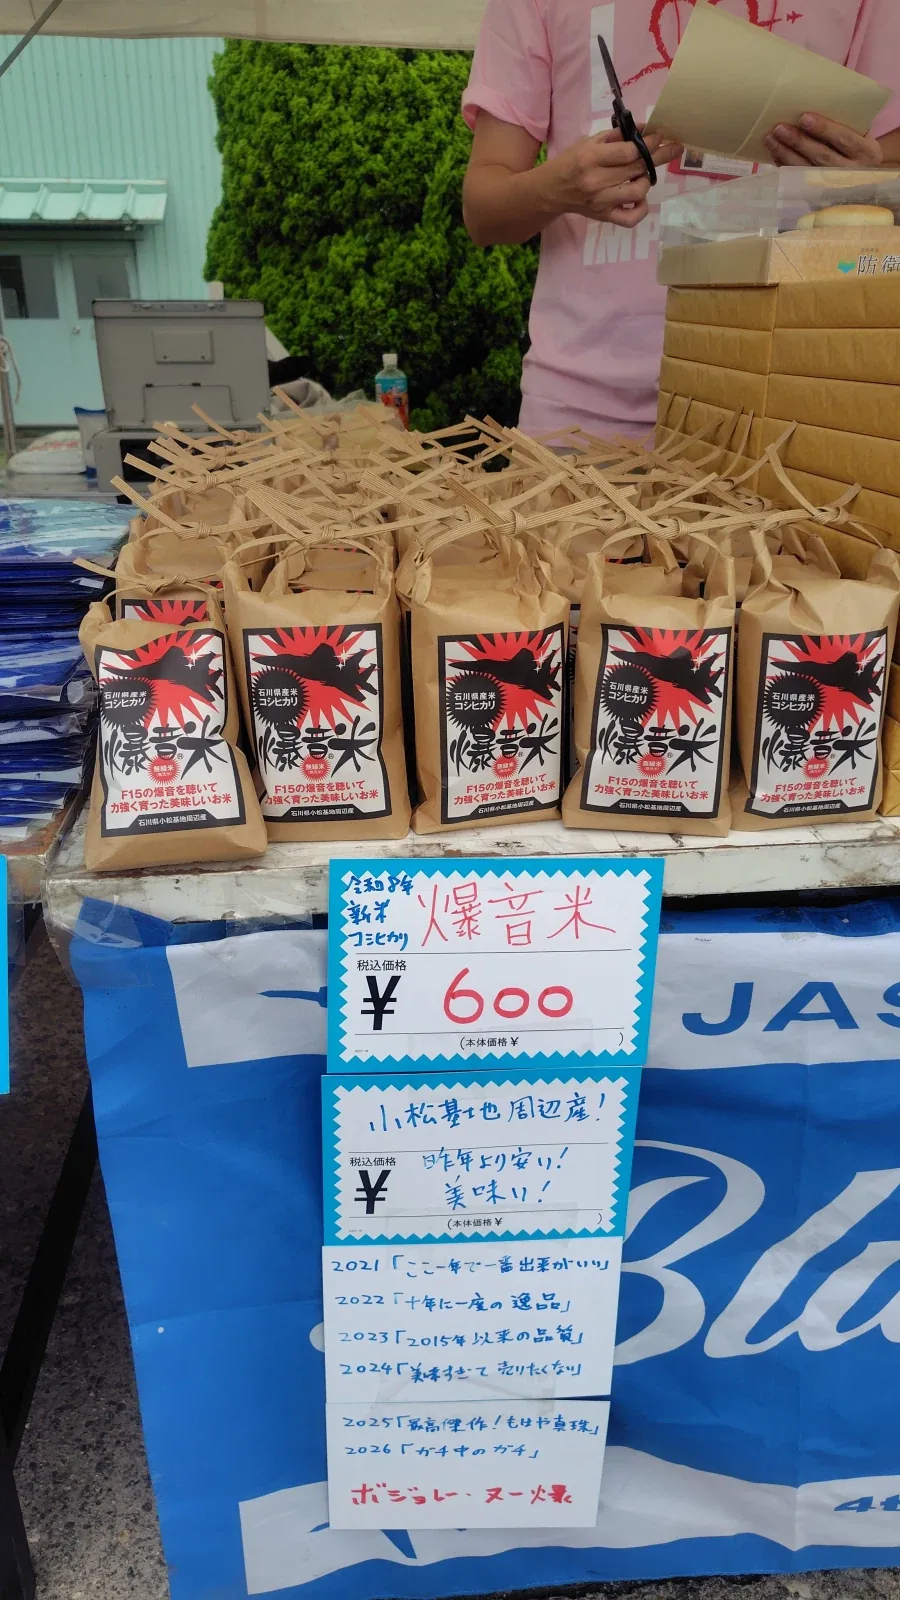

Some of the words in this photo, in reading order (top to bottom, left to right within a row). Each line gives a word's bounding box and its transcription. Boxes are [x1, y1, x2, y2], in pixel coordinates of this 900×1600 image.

[104, 691, 147, 700] 石川県産米
[258, 688, 298, 697] 石川県産米
[609, 682, 648, 695] 石川県産米
[105, 697, 146, 709] コシヒカリ
[259, 697, 298, 707] コシヒカリ
[454, 692, 496, 701] 石川県産米
[608, 690, 648, 705] コシヒカリ
[772, 692, 815, 702] 石川県産米
[454, 700, 496, 711] コシヒカリ
[771, 701, 814, 712] コシヒカリ
[274, 780, 365, 794] F15の爆音を聴いて
[466, 773, 547, 793] F15の爆音を聴いて
[608, 776, 698, 790] F15の爆音を聴いて
[775, 777, 857, 793] F15の爆音を聴いて
[121, 782, 218, 799] F15の爆音を聴いて
[264, 790, 378, 805] 力強く育った美味しいお米
[454, 781, 556, 805] 力強く育った美味しいお米
[594, 784, 708, 800] 力強く育った美味しいお米
[760, 785, 865, 803] 力強く育った美味しいお米
[111, 793, 232, 814] 力強く育った美味しいお米
[619, 802, 682, 812] 石川県小松基地周辺産
[291, 808, 354, 816] 石川県小松基地周辺産
[138, 814, 207, 826] 石川県小松基地周辺産
[347, 899, 390, 925] 新米
[418, 882, 616, 946] 爆音米
[348, 931, 408, 951] コシヒカリ
[357, 960, 407, 972] 税込価格
[361, 976, 402, 1031] ¥
[443, 968, 574, 1024] 600
[350, 1156, 396, 1167] 税込価格
[354, 1169, 392, 1214] ¥
